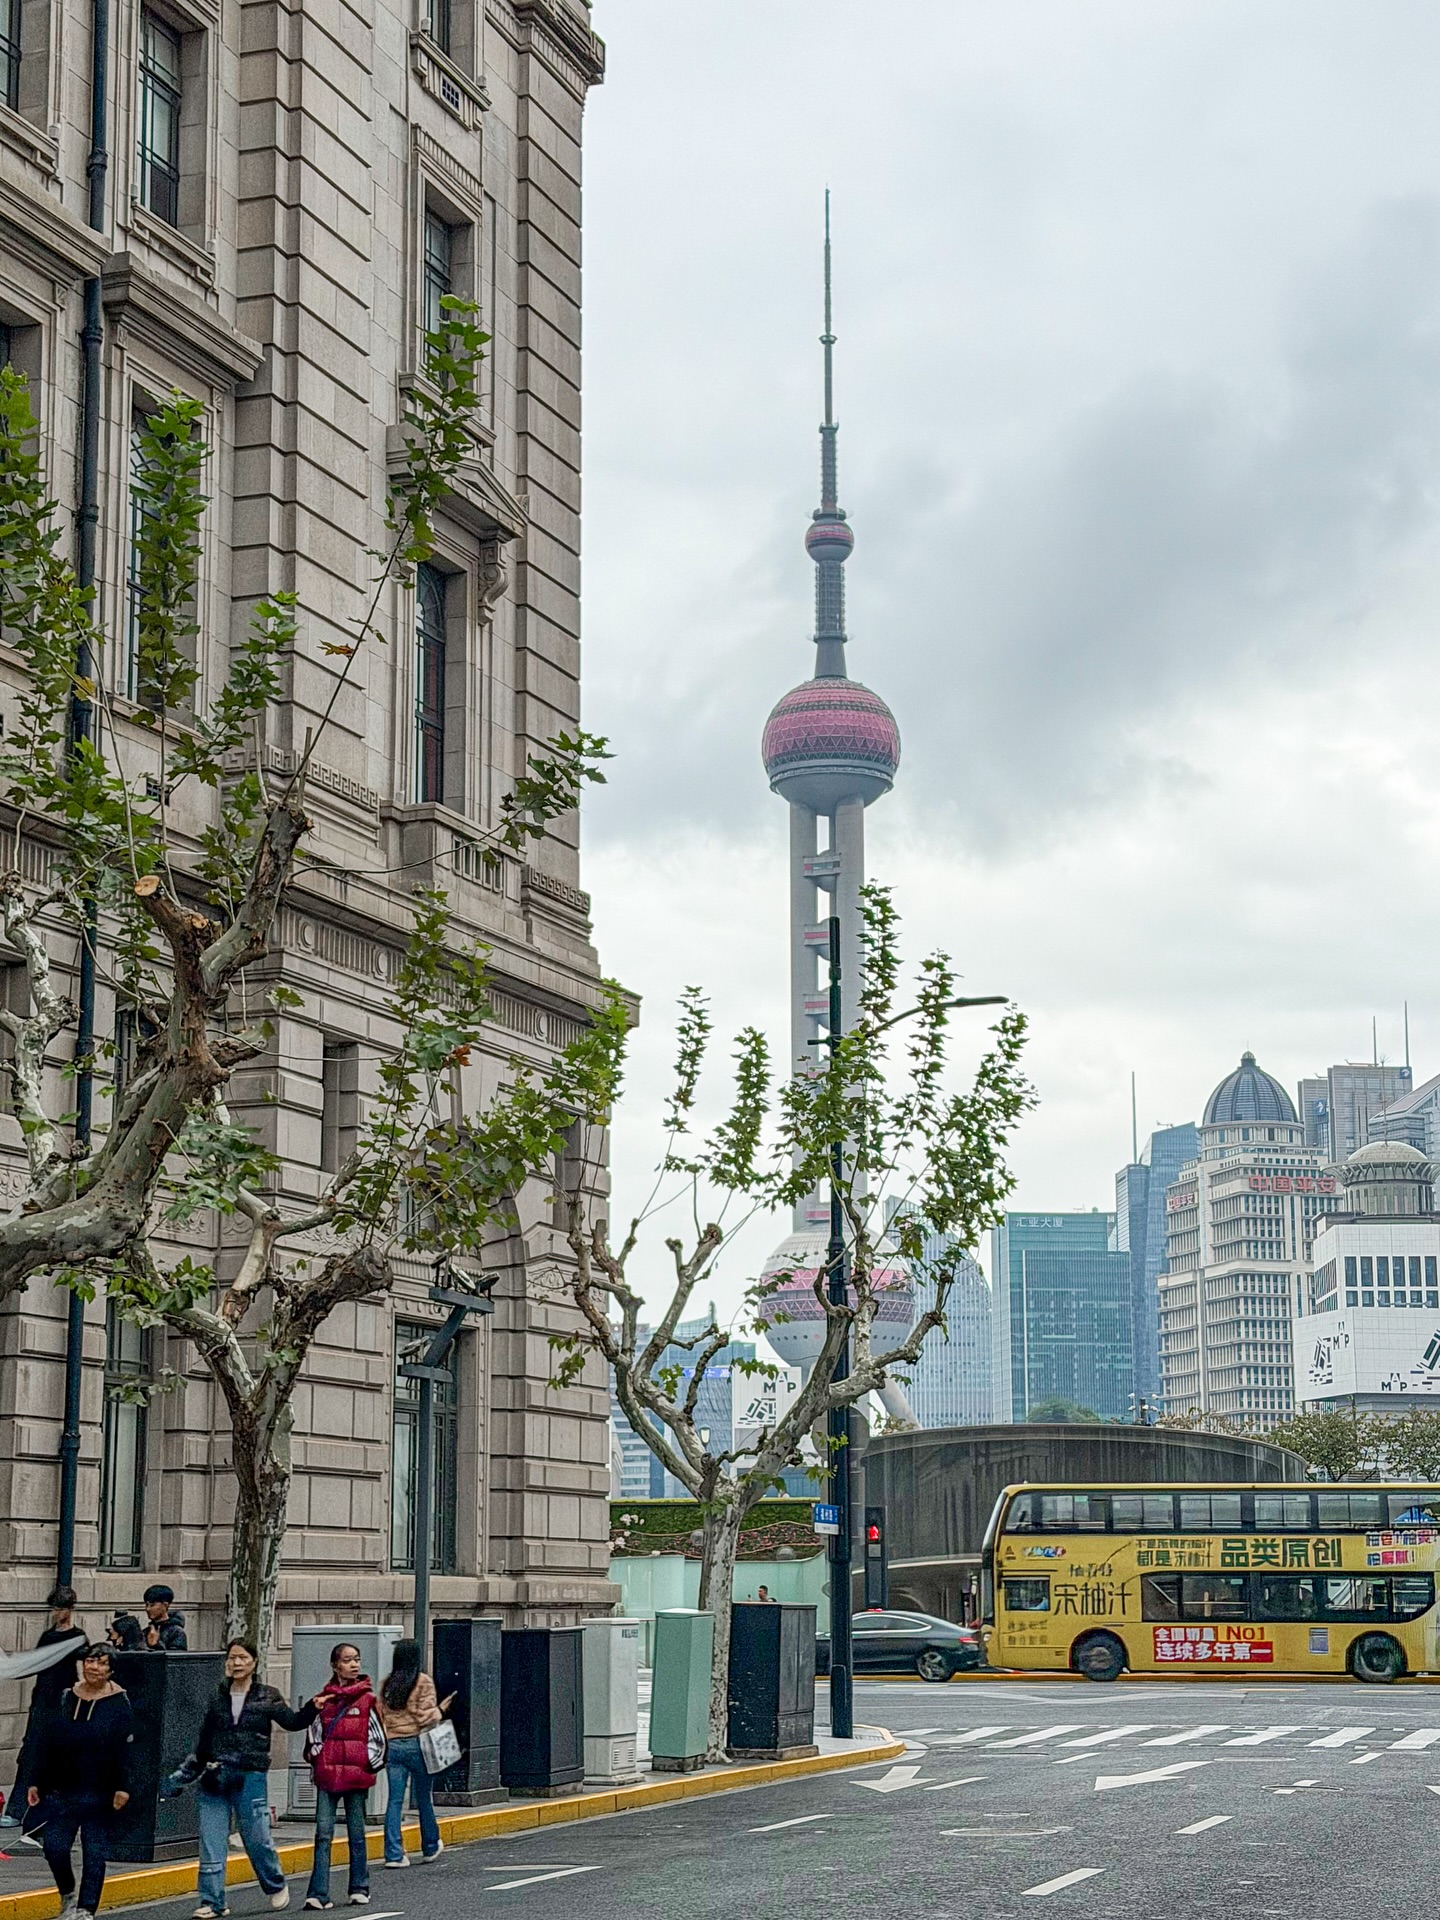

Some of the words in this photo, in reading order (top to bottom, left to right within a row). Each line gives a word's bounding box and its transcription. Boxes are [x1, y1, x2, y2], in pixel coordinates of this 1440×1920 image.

[1249, 1175, 1337, 1194] 中国平安
[1016, 1216, 1064, 1228] 汇亚大厦
[1381, 1372, 1408, 1392] MAP
[1221, 1538, 1343, 1567] 品类原创
[1053, 1582, 1133, 1615] 宋柚汁
[1155, 1642, 1271, 1661] 连续多年第一
